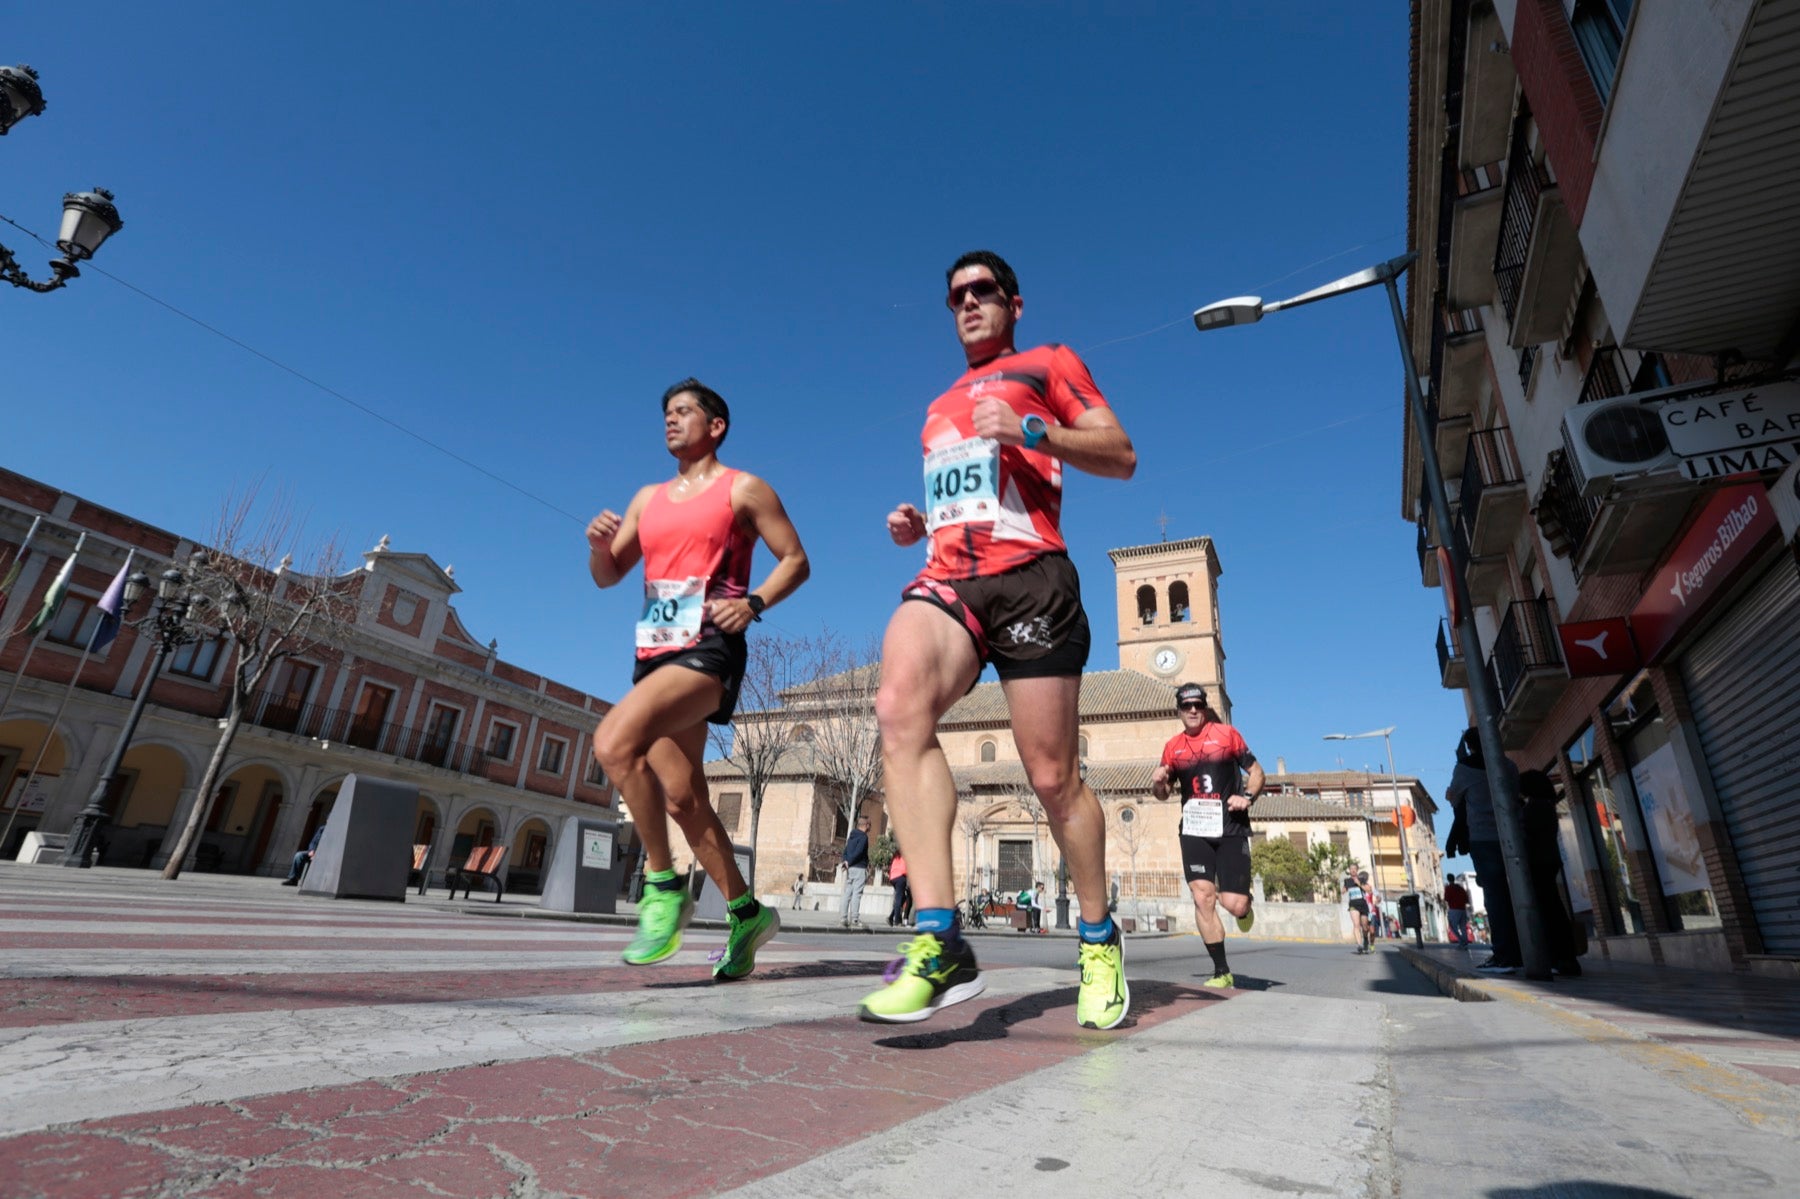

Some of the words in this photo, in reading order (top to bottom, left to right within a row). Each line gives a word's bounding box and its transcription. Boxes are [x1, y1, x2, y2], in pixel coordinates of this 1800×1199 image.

[1667, 393, 1763, 426] CAFÉ
[1685, 443, 1800, 479] LIMA
[933, 463, 982, 500] 405
[1682, 540, 1723, 595] Seguros
[1717, 495, 1758, 551] Bilbao
